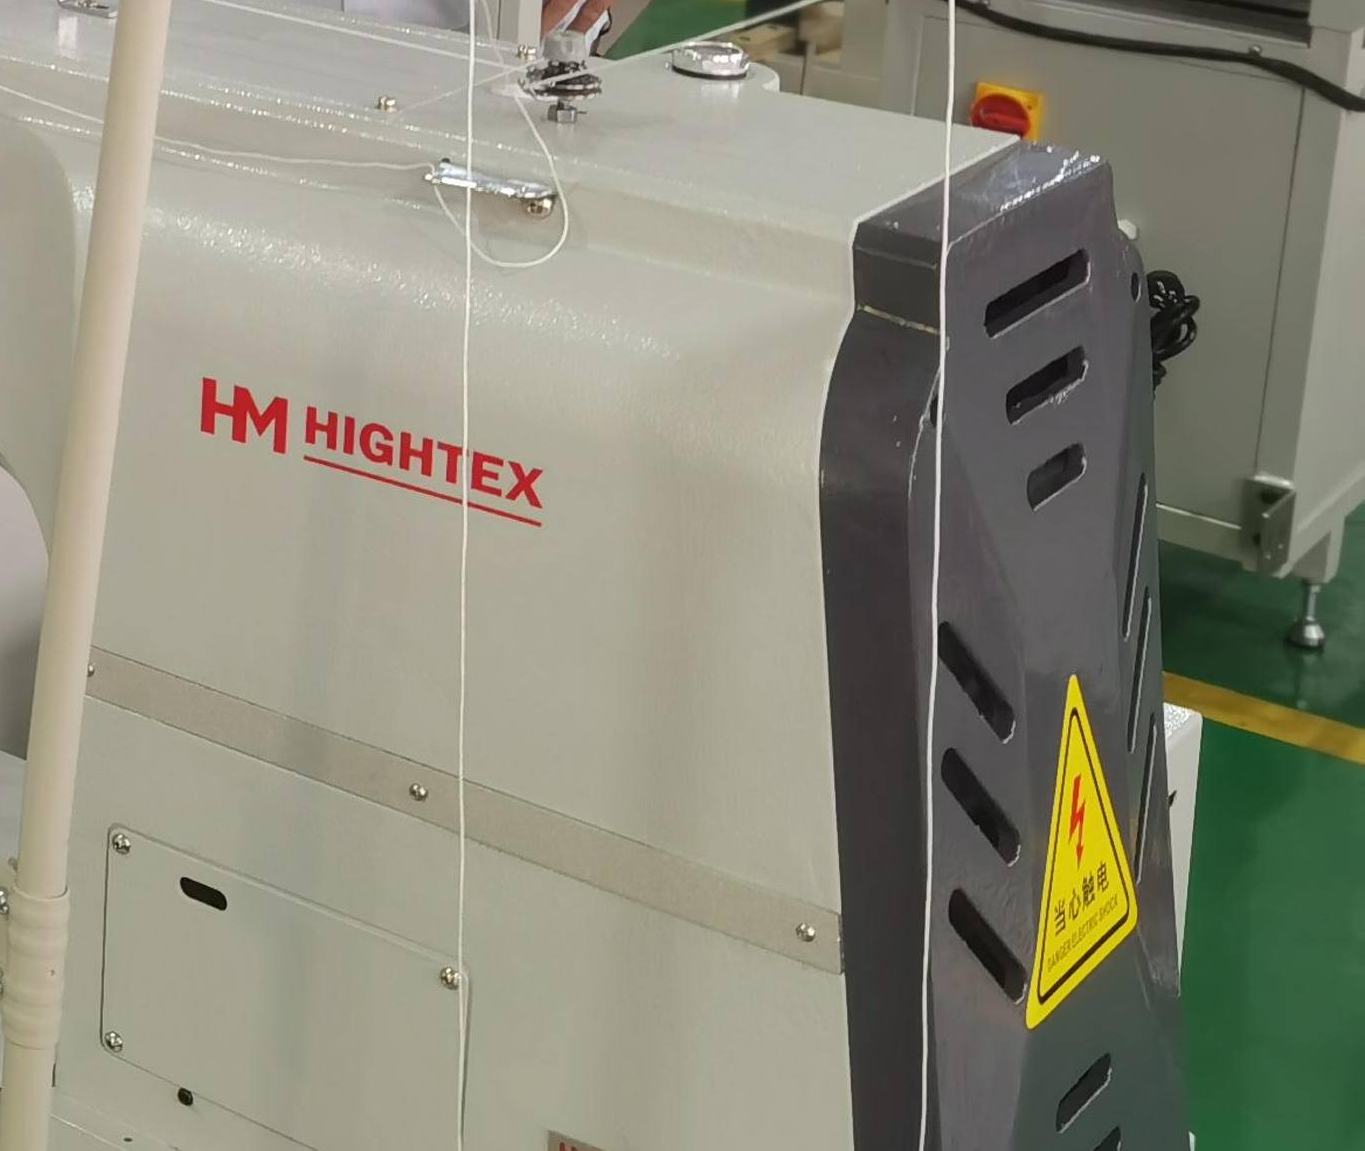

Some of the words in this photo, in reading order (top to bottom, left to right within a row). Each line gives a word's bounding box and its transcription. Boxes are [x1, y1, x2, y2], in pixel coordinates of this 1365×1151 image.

[200, 376, 289, 455] HM
[304, 405, 544, 510] HIGHTEX
[1054, 860, 1109, 936] 当心触电
